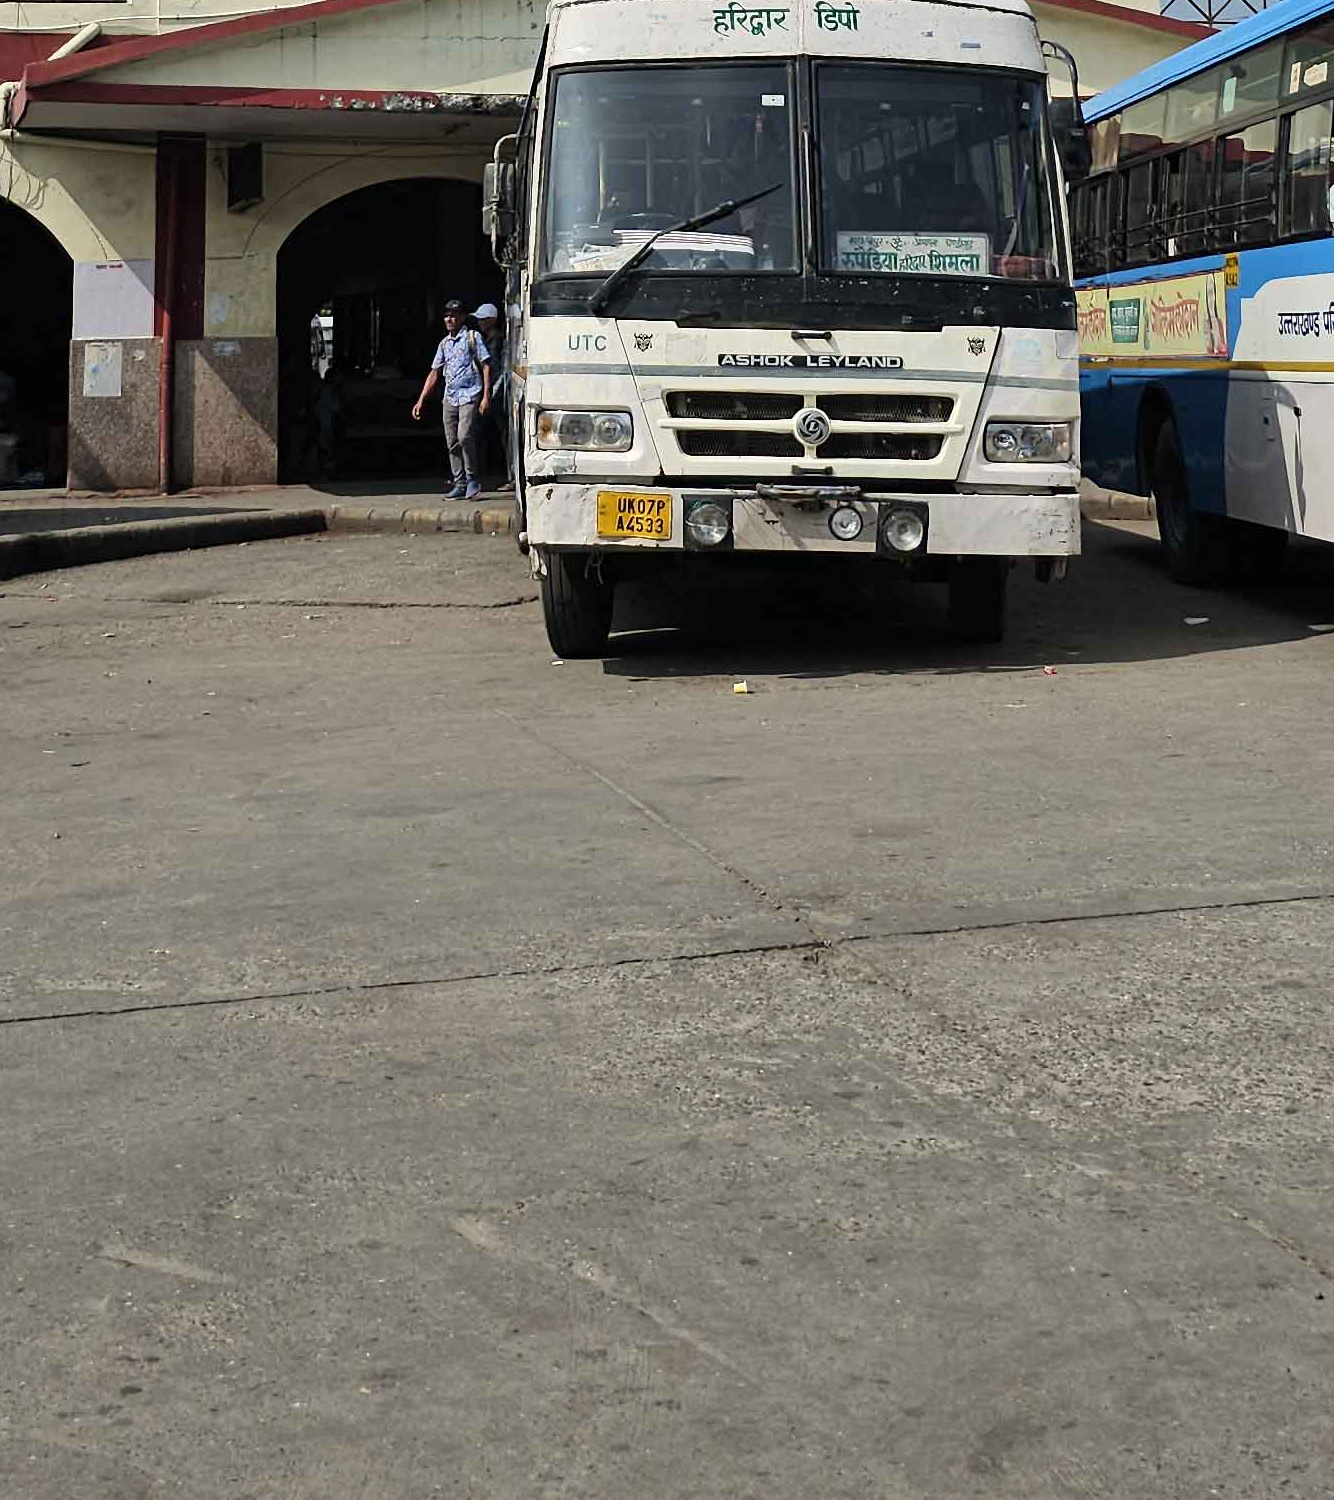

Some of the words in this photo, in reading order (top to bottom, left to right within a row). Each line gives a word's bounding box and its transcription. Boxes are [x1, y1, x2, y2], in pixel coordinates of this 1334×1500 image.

[712, 1, 790, 38] हरिद्वार
[813, 0, 860, 32] डिपो
[927, 249, 981, 272] शिमला
[567, 334, 608, 351] UTC
[720, 354, 794, 368] ASHOK
[806, 355, 901, 368] LEYLAND
[617, 497, 666, 516] UK07P
[616, 515, 664, 534] A4533
